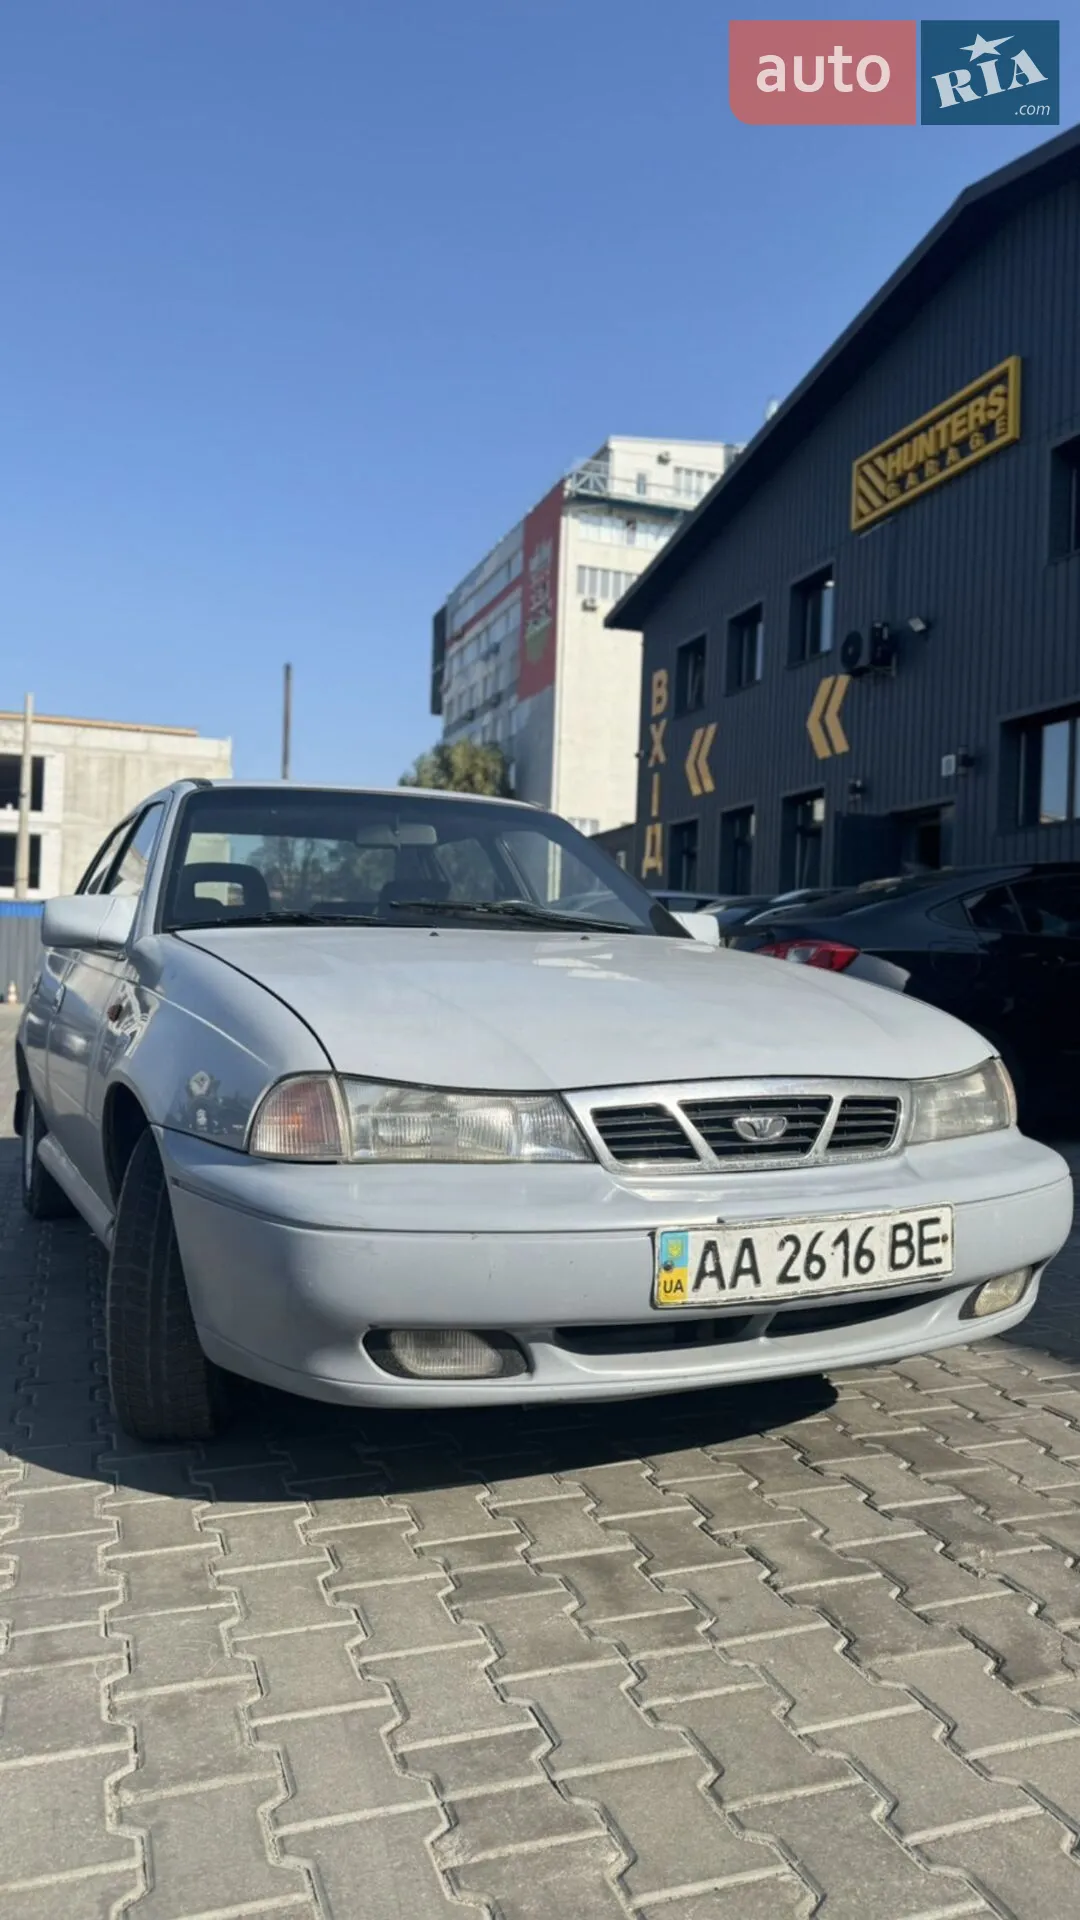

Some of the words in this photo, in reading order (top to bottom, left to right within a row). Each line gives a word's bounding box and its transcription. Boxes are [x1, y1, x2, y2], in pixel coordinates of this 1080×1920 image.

[886, 384, 1007, 479] HUNTERS
[886, 415, 1008, 500] GARAGE
[641, 668, 669, 879] ВХІД
[662, 1279, 684, 1294] UA
[692, 1237, 762, 1291] AA
[776, 1226, 876, 1285] 2616
[888, 1217, 943, 1272] BE
